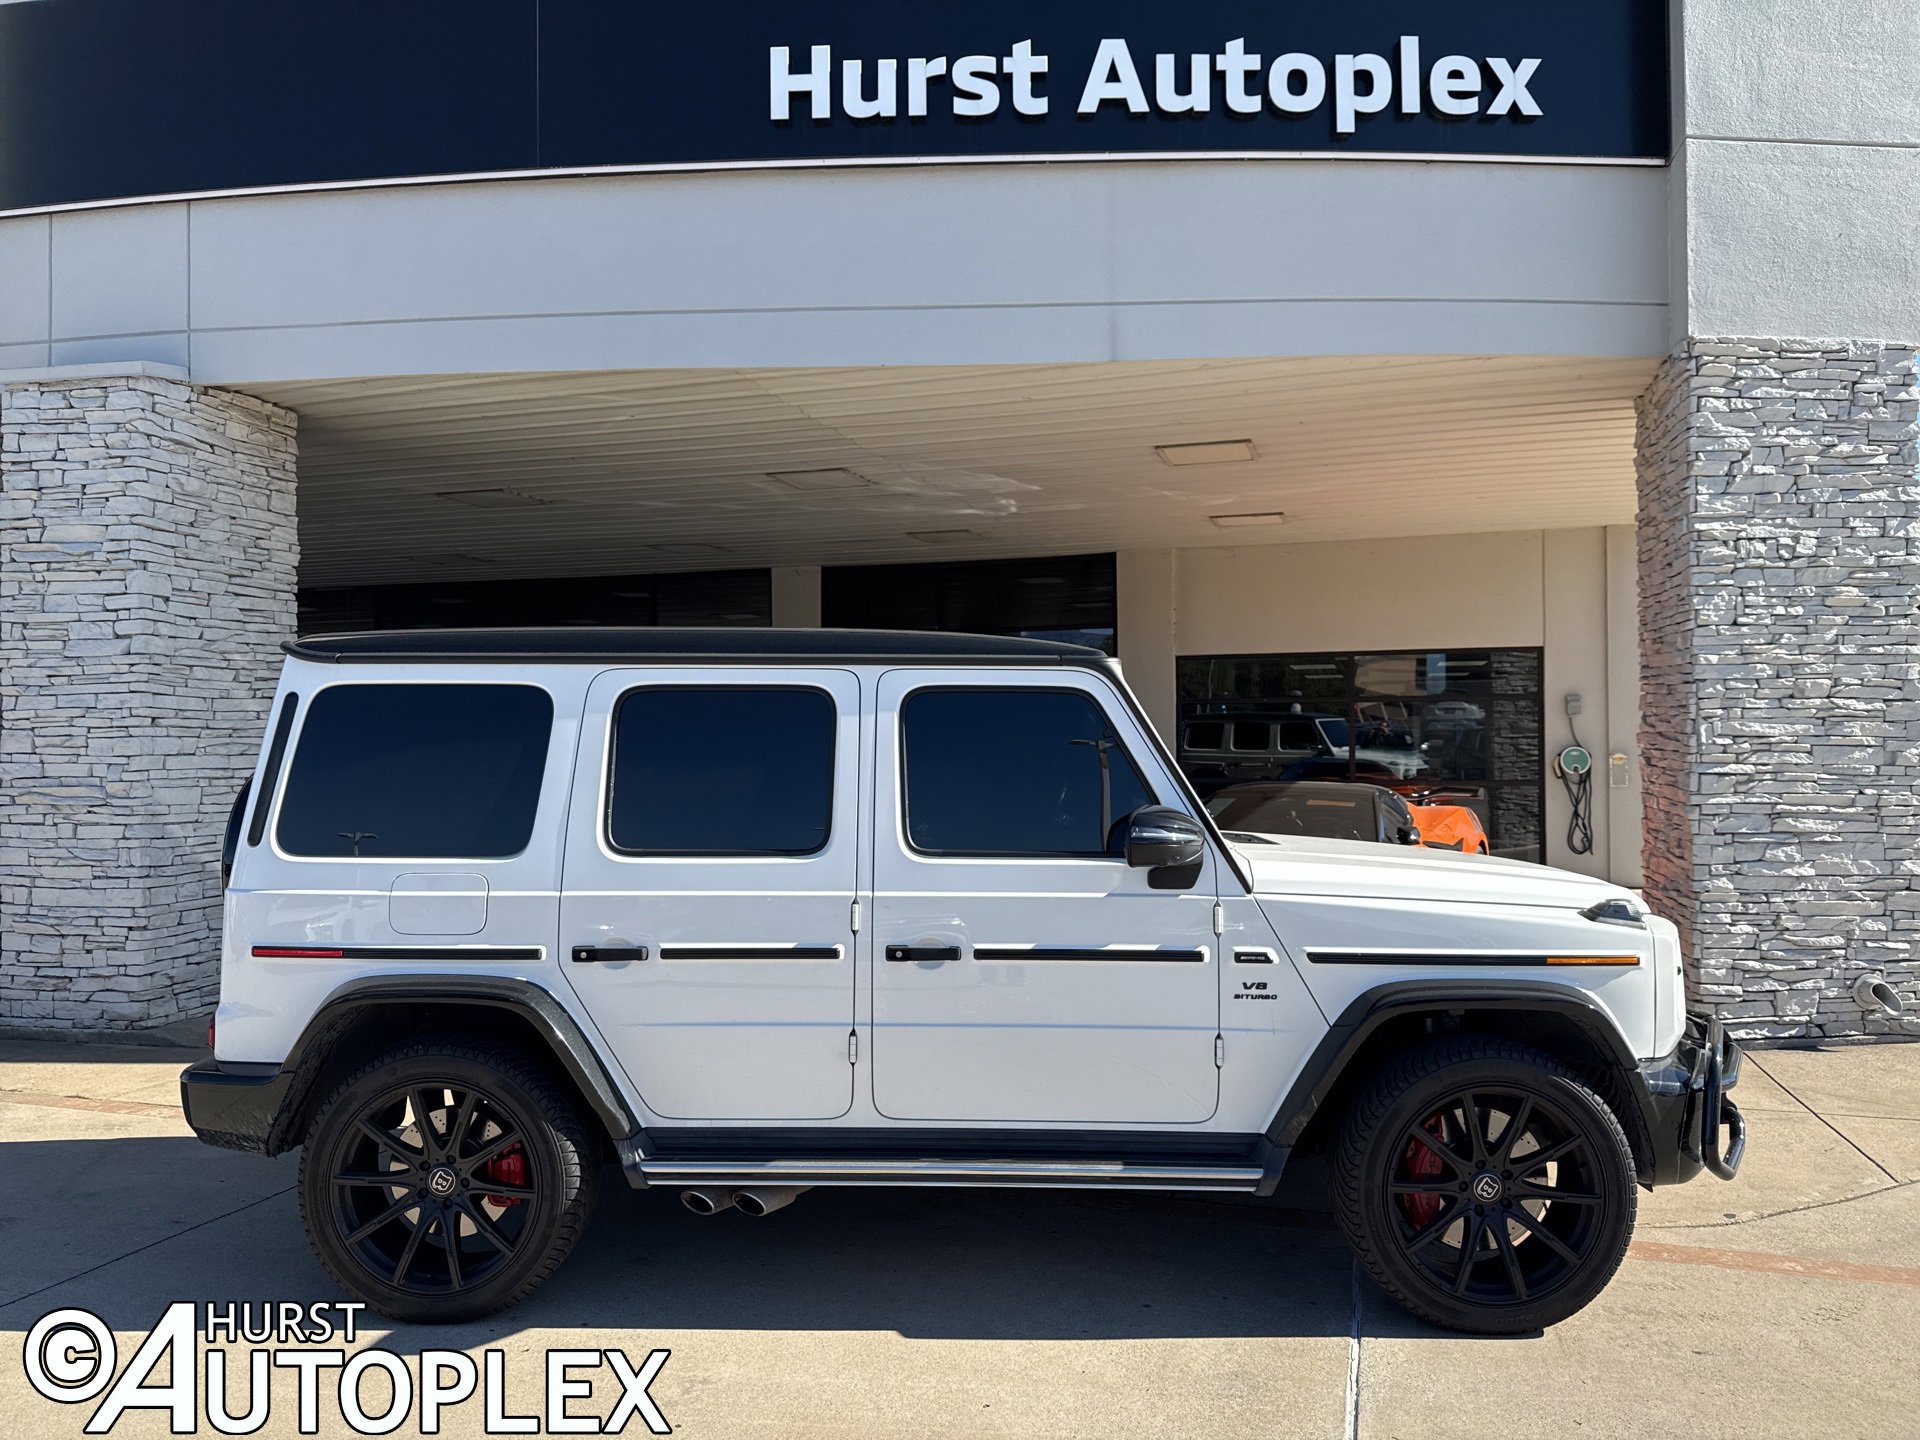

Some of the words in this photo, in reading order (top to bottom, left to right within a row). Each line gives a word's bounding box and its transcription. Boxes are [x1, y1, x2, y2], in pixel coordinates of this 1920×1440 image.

[769, 38, 1050, 120] Hurst
[1077, 35, 1544, 134] Autoplex
[1242, 982, 1268, 990] V8
